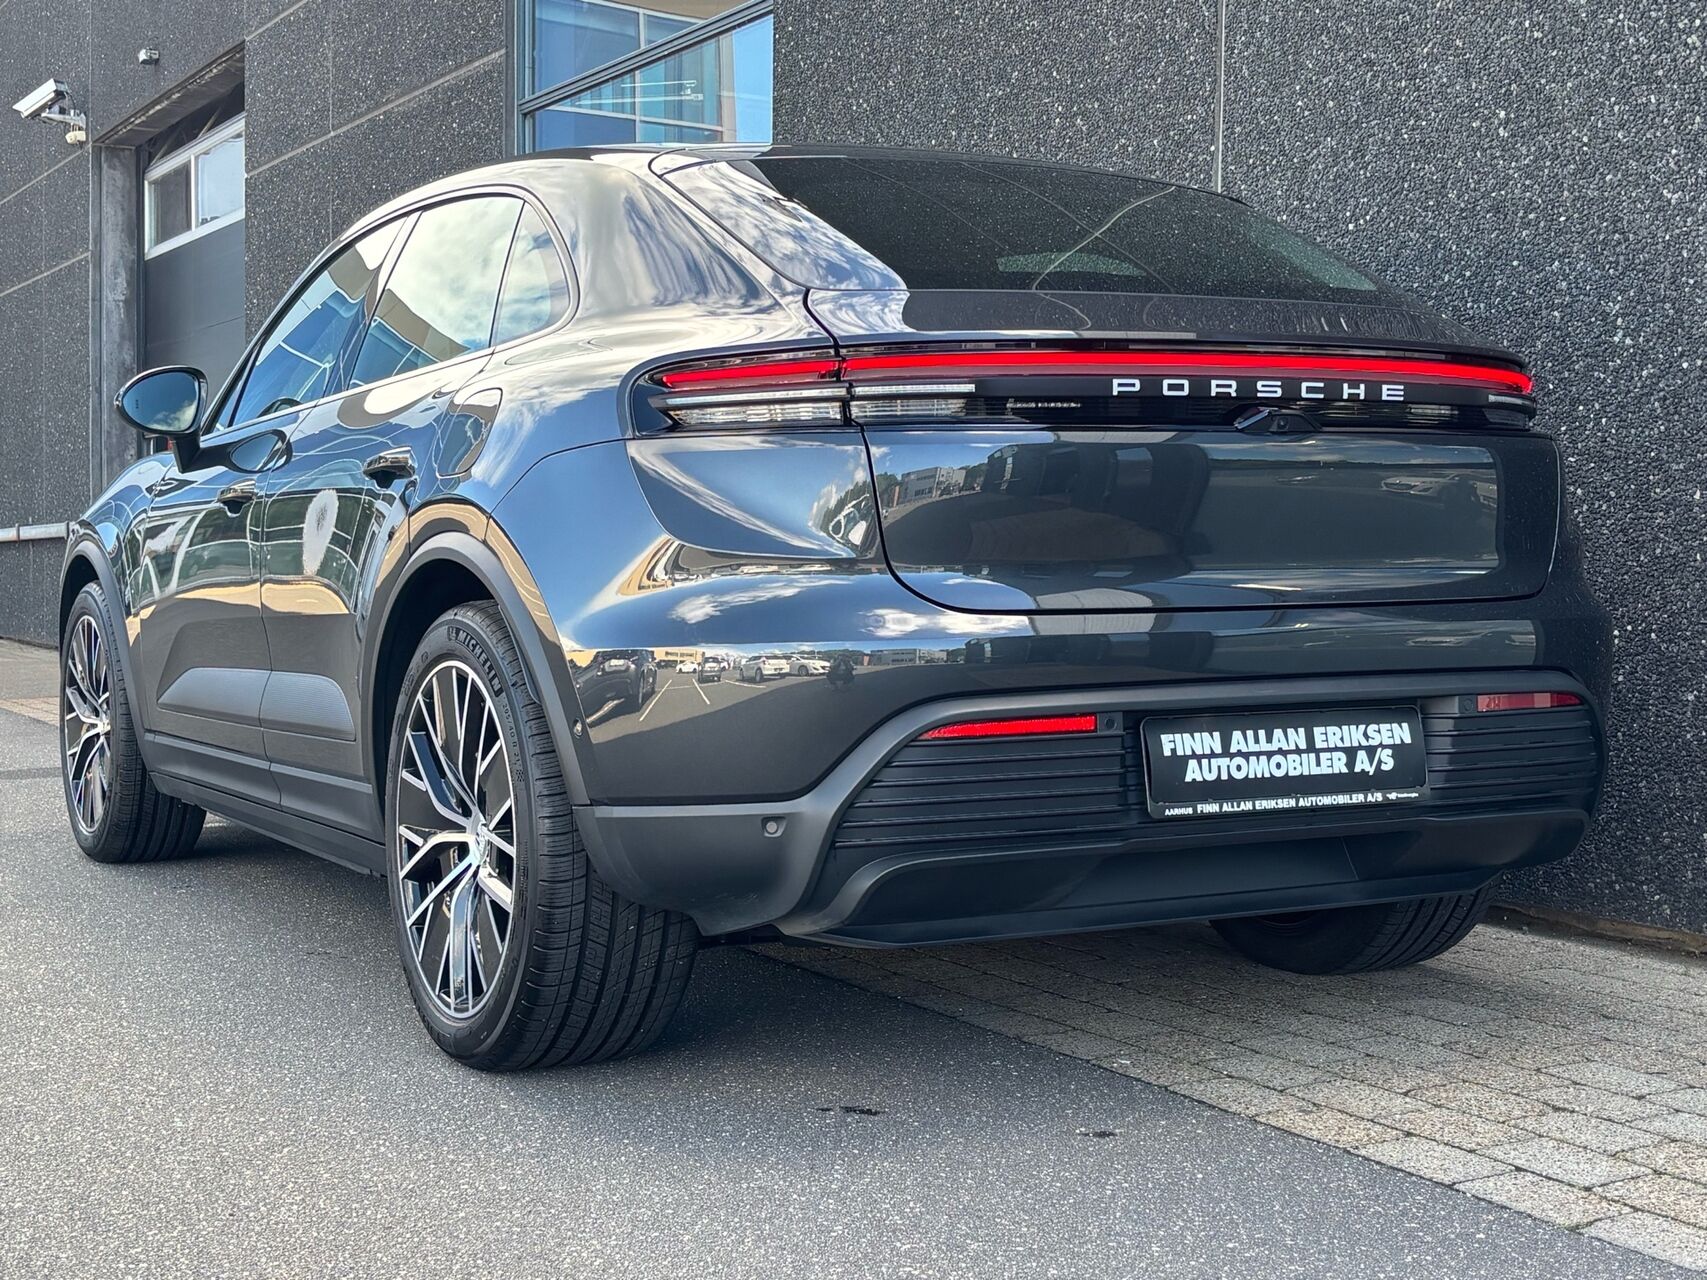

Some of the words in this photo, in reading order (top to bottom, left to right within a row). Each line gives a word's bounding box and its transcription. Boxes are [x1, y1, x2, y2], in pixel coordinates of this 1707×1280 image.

[1112, 378, 1405, 401] PORSCHE
[457, 629, 502, 693] MICHELIN
[1160, 731, 1222, 757] FINN
[1229, 727, 1307, 753] ALLAN
[1313, 722, 1412, 749] ERIKSEN
[1184, 751, 1349, 783] AUTOMOBILER
[1354, 748, 1395, 776] A/S
[1164, 806, 1193, 816] AARHUS
[1197, 802, 1220, 814] FINN
[1222, 800, 1254, 812] ALLAN
[1255, 797, 1296, 811] ERIKSEN
[1298, 793, 1366, 808] AUTOMOBILER
[1366, 792, 1384, 803] A/S
